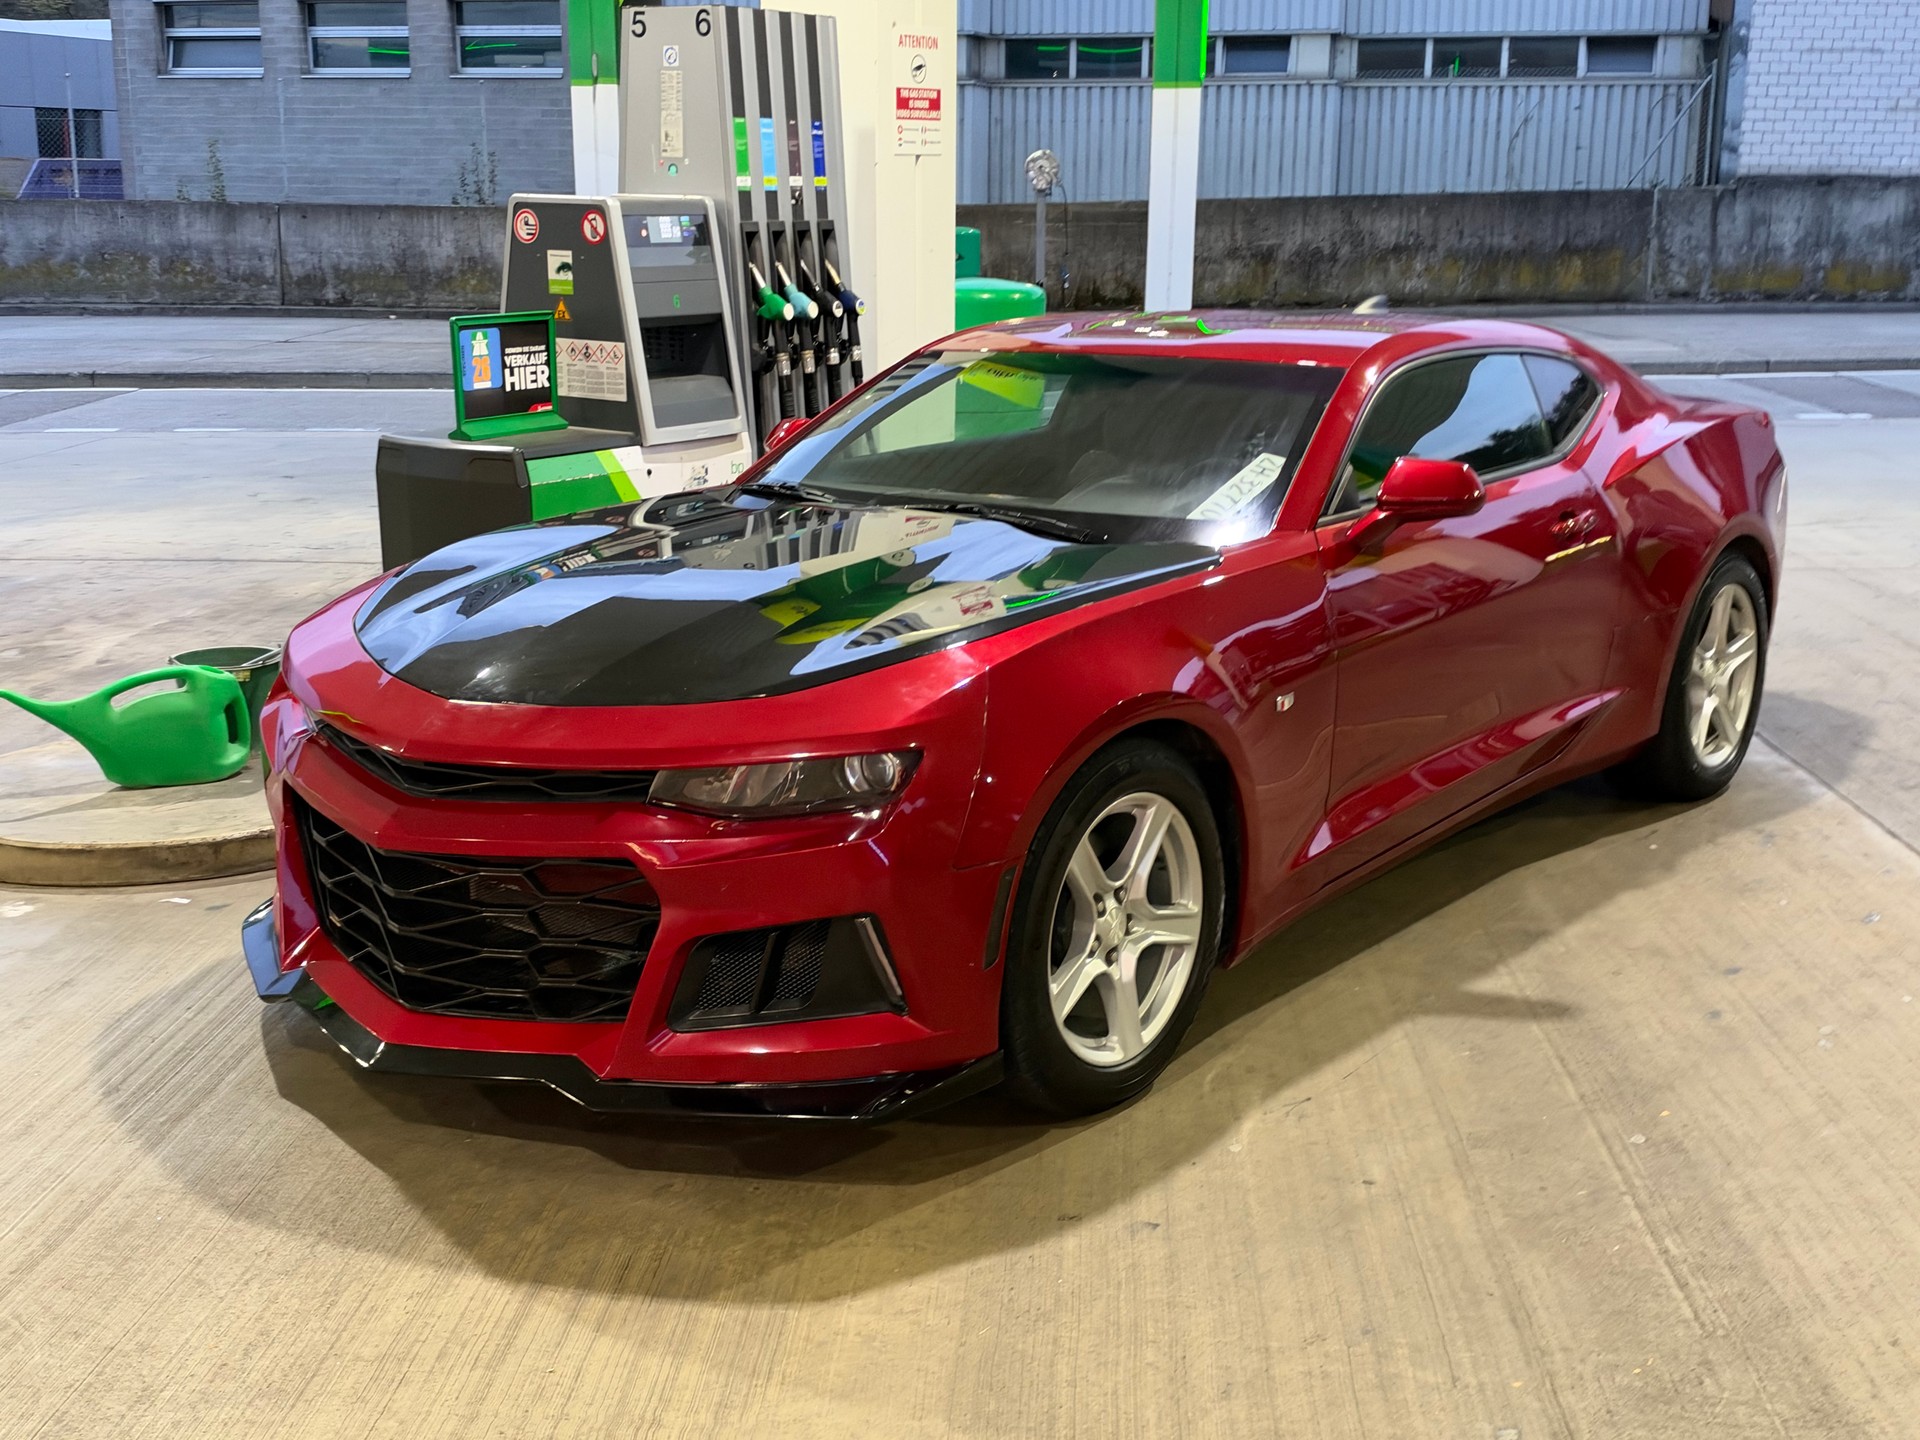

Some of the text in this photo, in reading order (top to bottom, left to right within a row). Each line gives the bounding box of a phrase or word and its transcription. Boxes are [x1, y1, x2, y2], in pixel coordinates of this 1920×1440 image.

[631, 11, 647, 38] 5
[695, 9, 711, 37] 6
[898, 34, 938, 50] ATTENTION
[900, 88, 909, 98] THE
[918, 89, 938, 99] STATION
[896, 108, 940, 119] VIDEO SURVEILLANCE
[673, 294, 680, 309] 6
[557, 310, 566, 318] EX
[504, 352, 548, 367] VERKAUF
[472, 356, 491, 382] 26
[504, 365, 550, 392] HIER
[731, 461, 744, 474] bp
